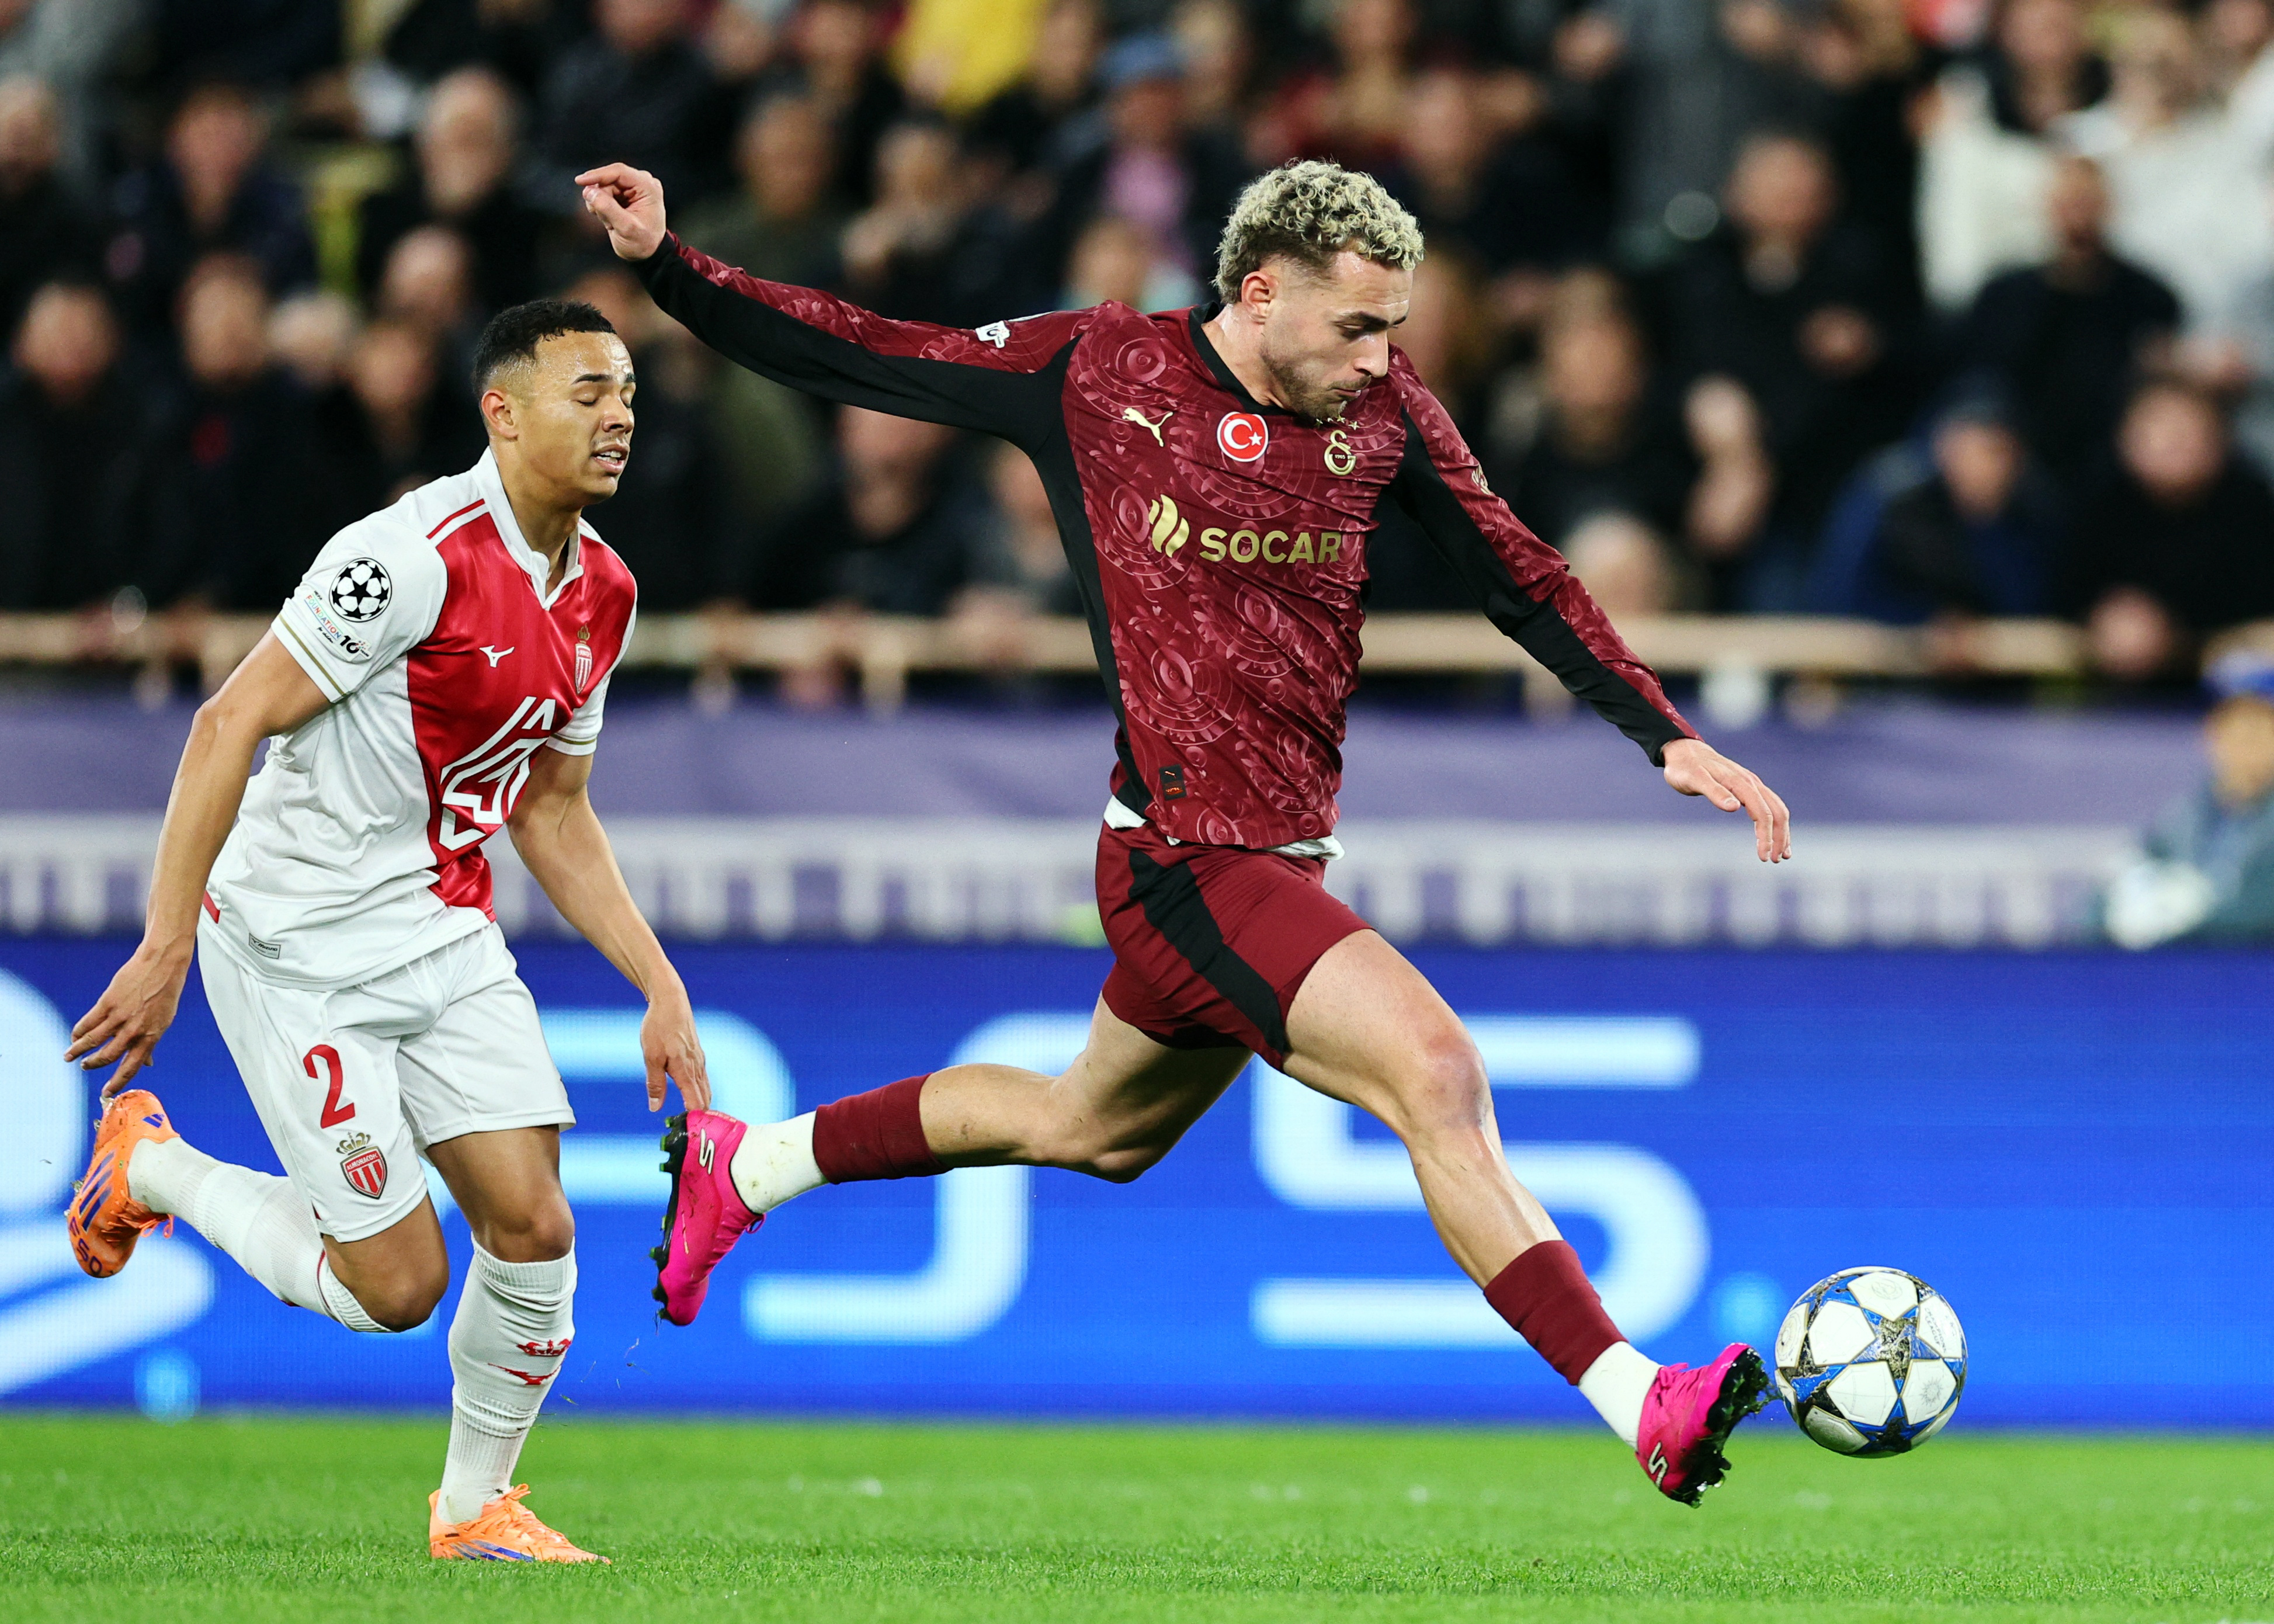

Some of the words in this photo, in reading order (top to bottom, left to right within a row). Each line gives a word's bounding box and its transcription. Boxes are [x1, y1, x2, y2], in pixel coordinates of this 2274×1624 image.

[1199, 528, 1342, 564] SOCAR
[305, 595, 342, 639] FOUNDATION
[303, 1044, 356, 1129] 2
